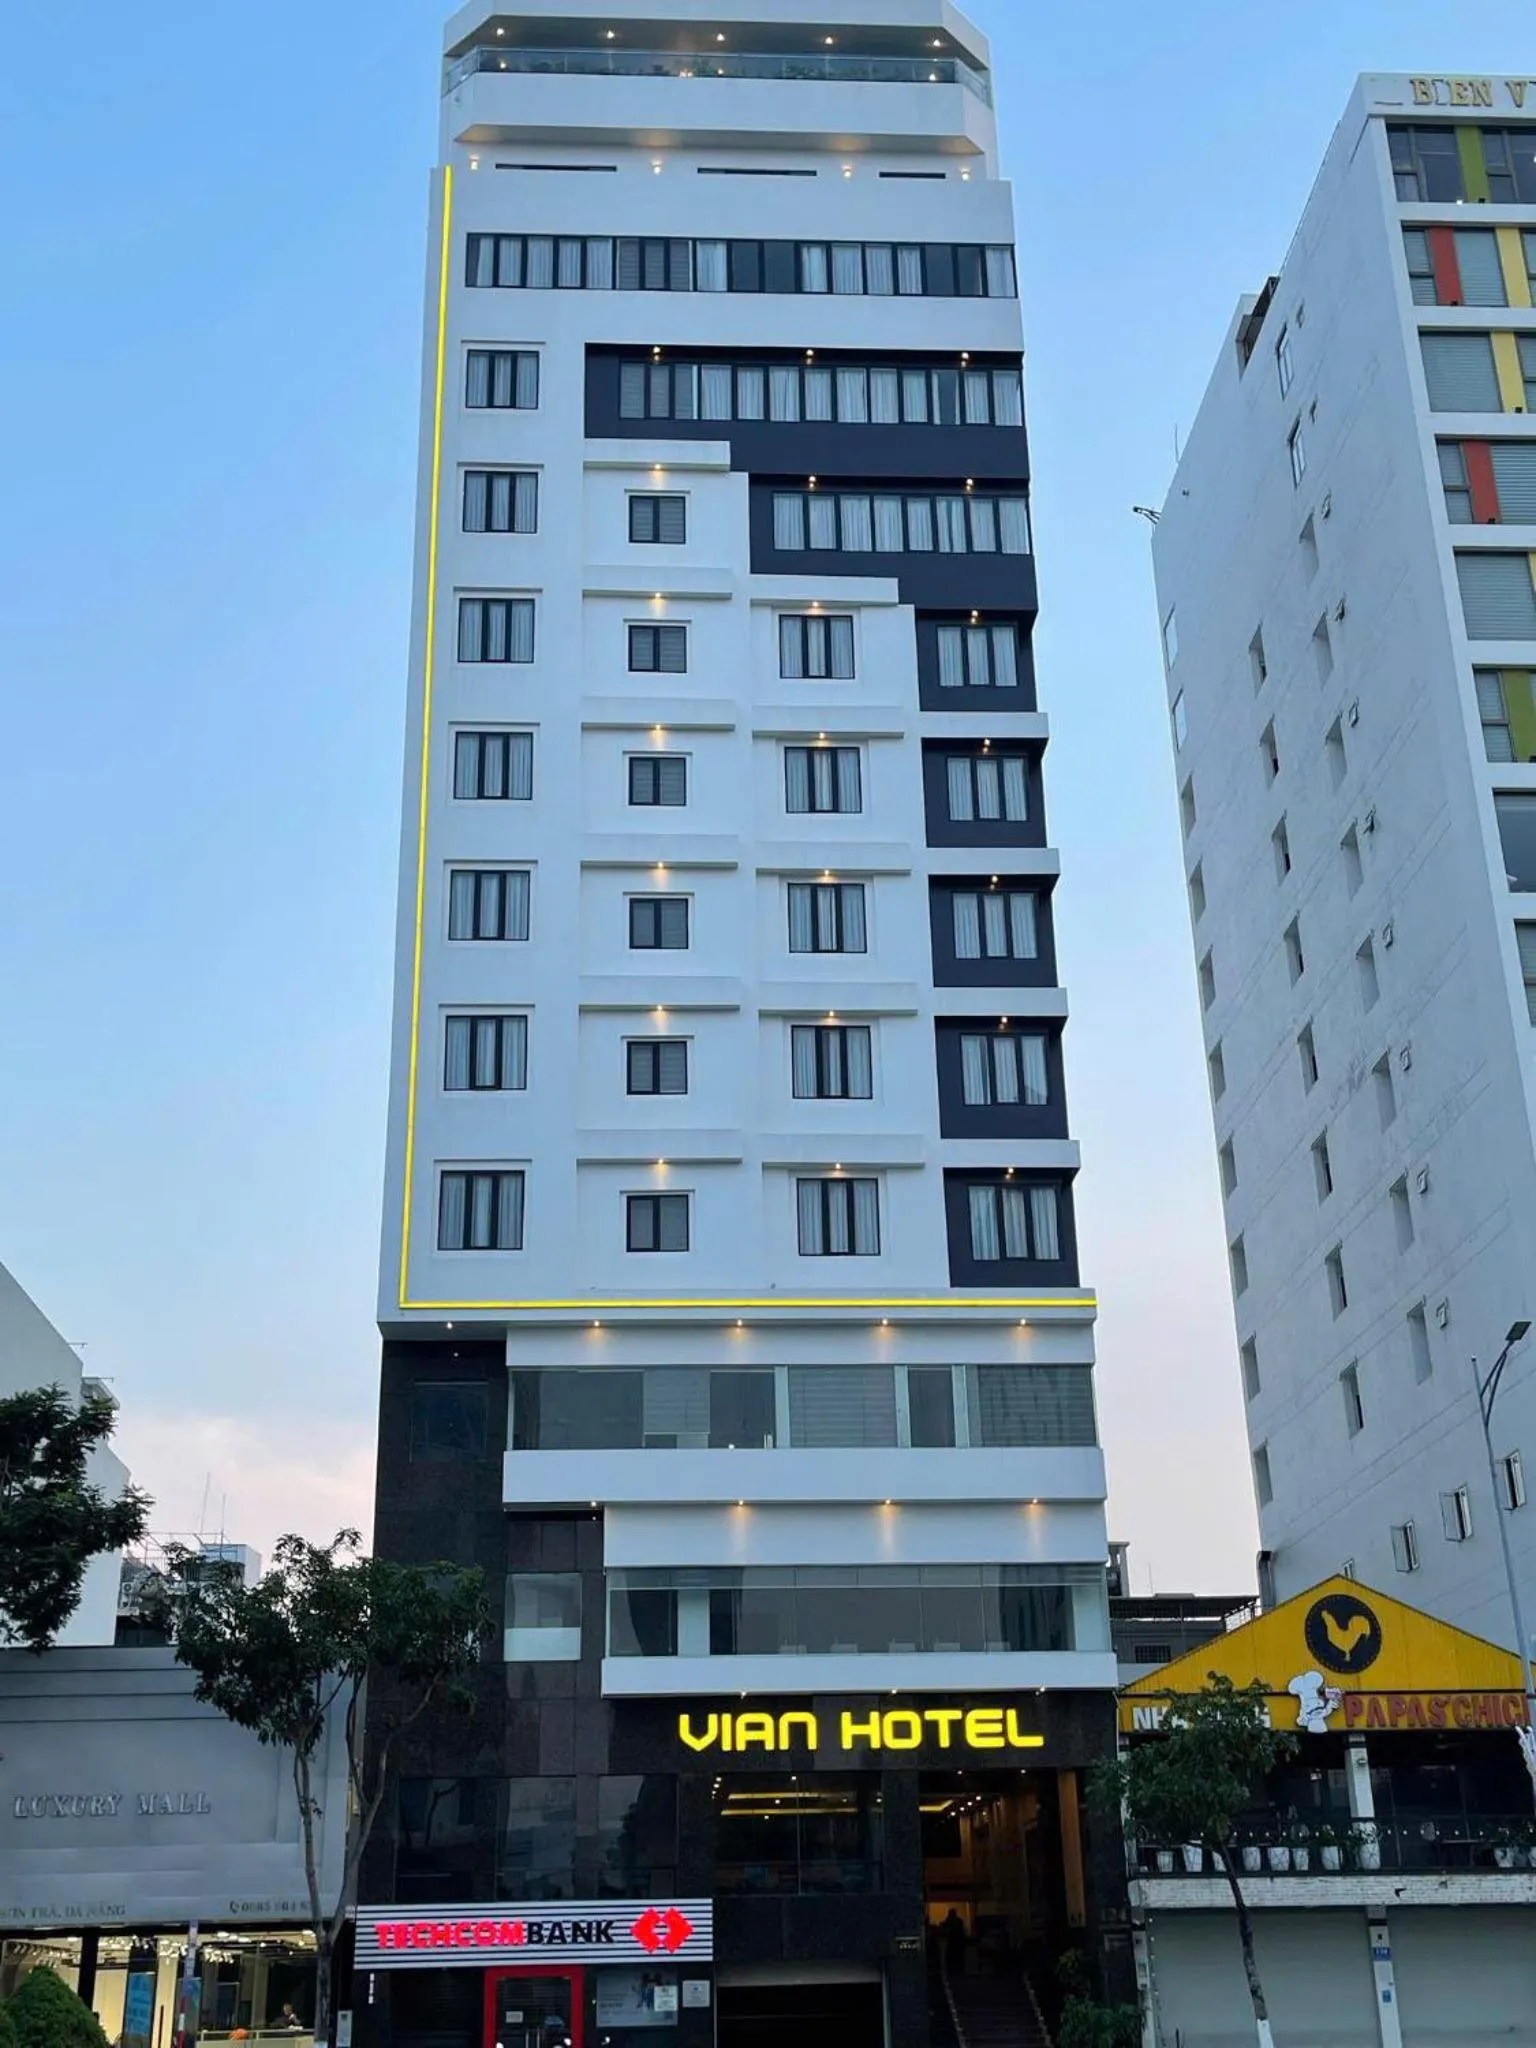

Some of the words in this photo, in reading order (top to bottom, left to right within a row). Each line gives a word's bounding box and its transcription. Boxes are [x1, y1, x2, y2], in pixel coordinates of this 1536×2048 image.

[1504, 79, 1536, 108] V
[678, 1711, 818, 1752] VIAN
[840, 1707, 1045, 1751] HOTEL
[13, 1791, 123, 1818] LUXURY
[138, 1791, 211, 1816] MALL
[375, 1920, 616, 1949] TECHCOMBANK
